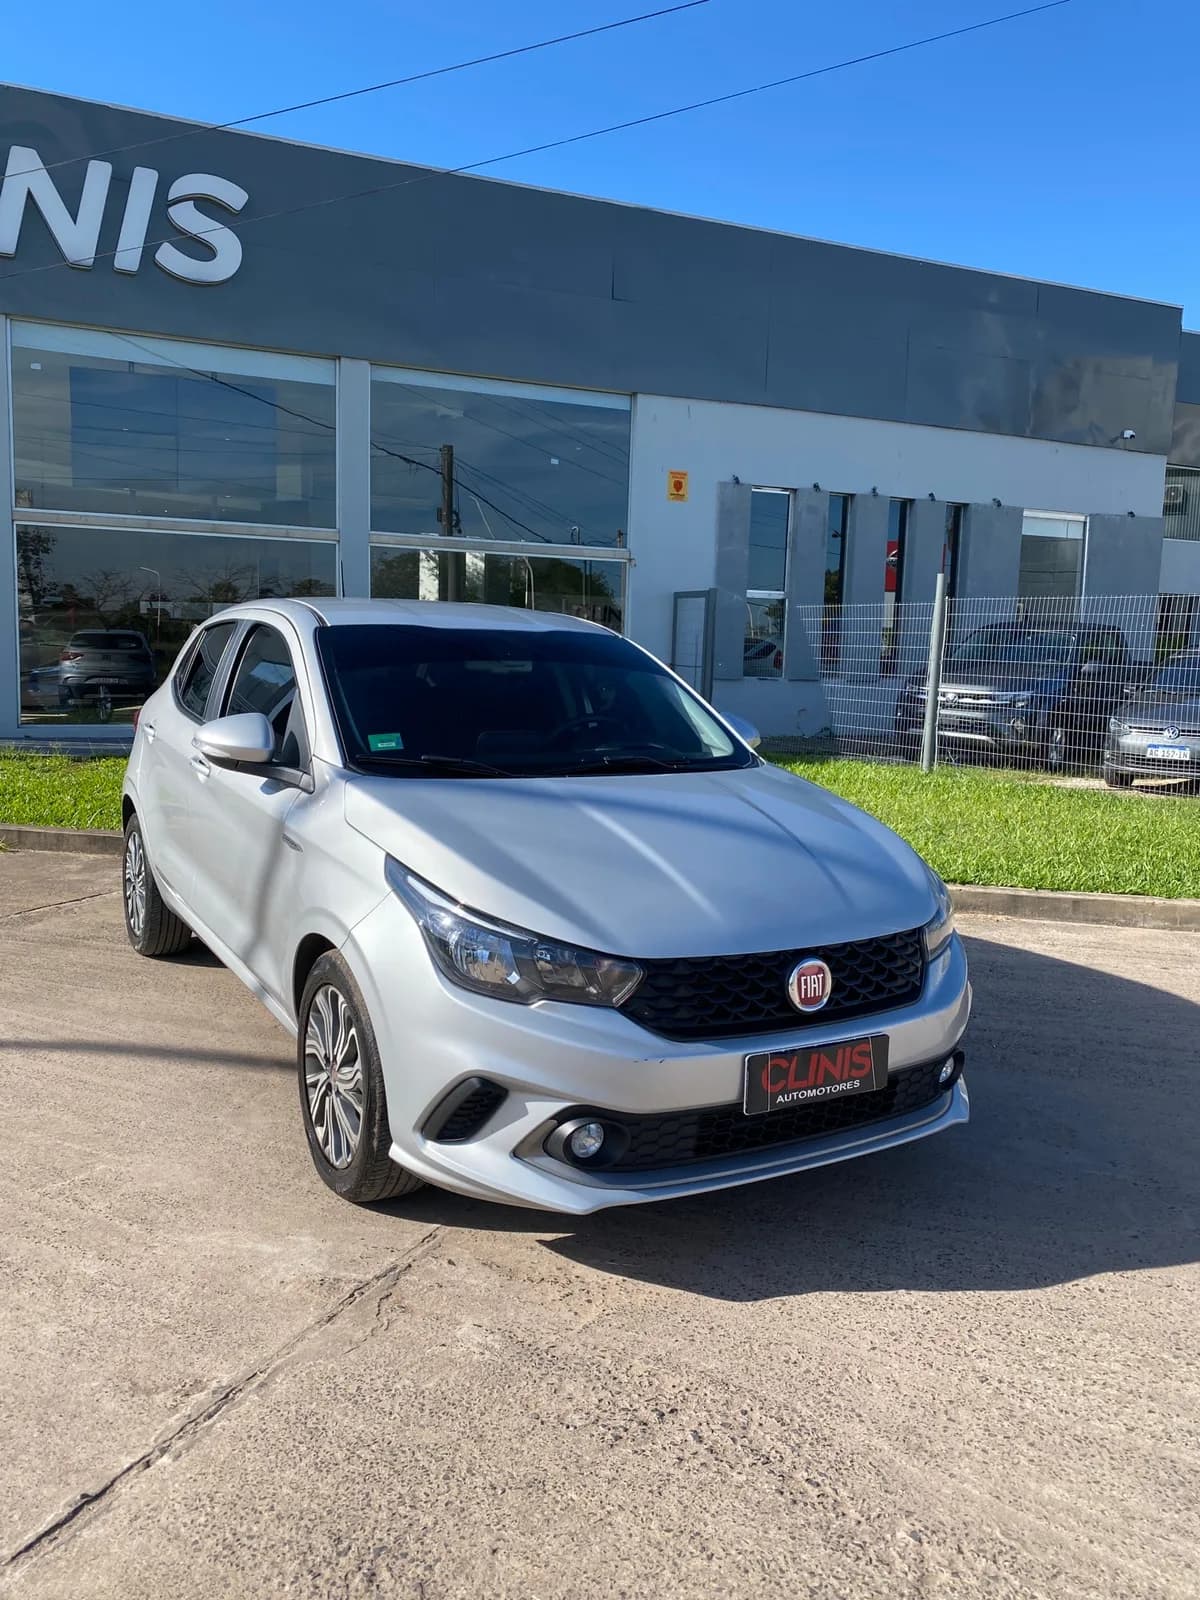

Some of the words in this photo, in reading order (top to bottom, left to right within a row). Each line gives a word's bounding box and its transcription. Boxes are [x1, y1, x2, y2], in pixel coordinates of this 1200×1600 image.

[0, 145, 249, 285] NIS
[801, 973, 824, 999] FIAT
[761, 1043, 872, 1093] CLINIS
[776, 1079, 861, 1104] AUTOMOTORES
